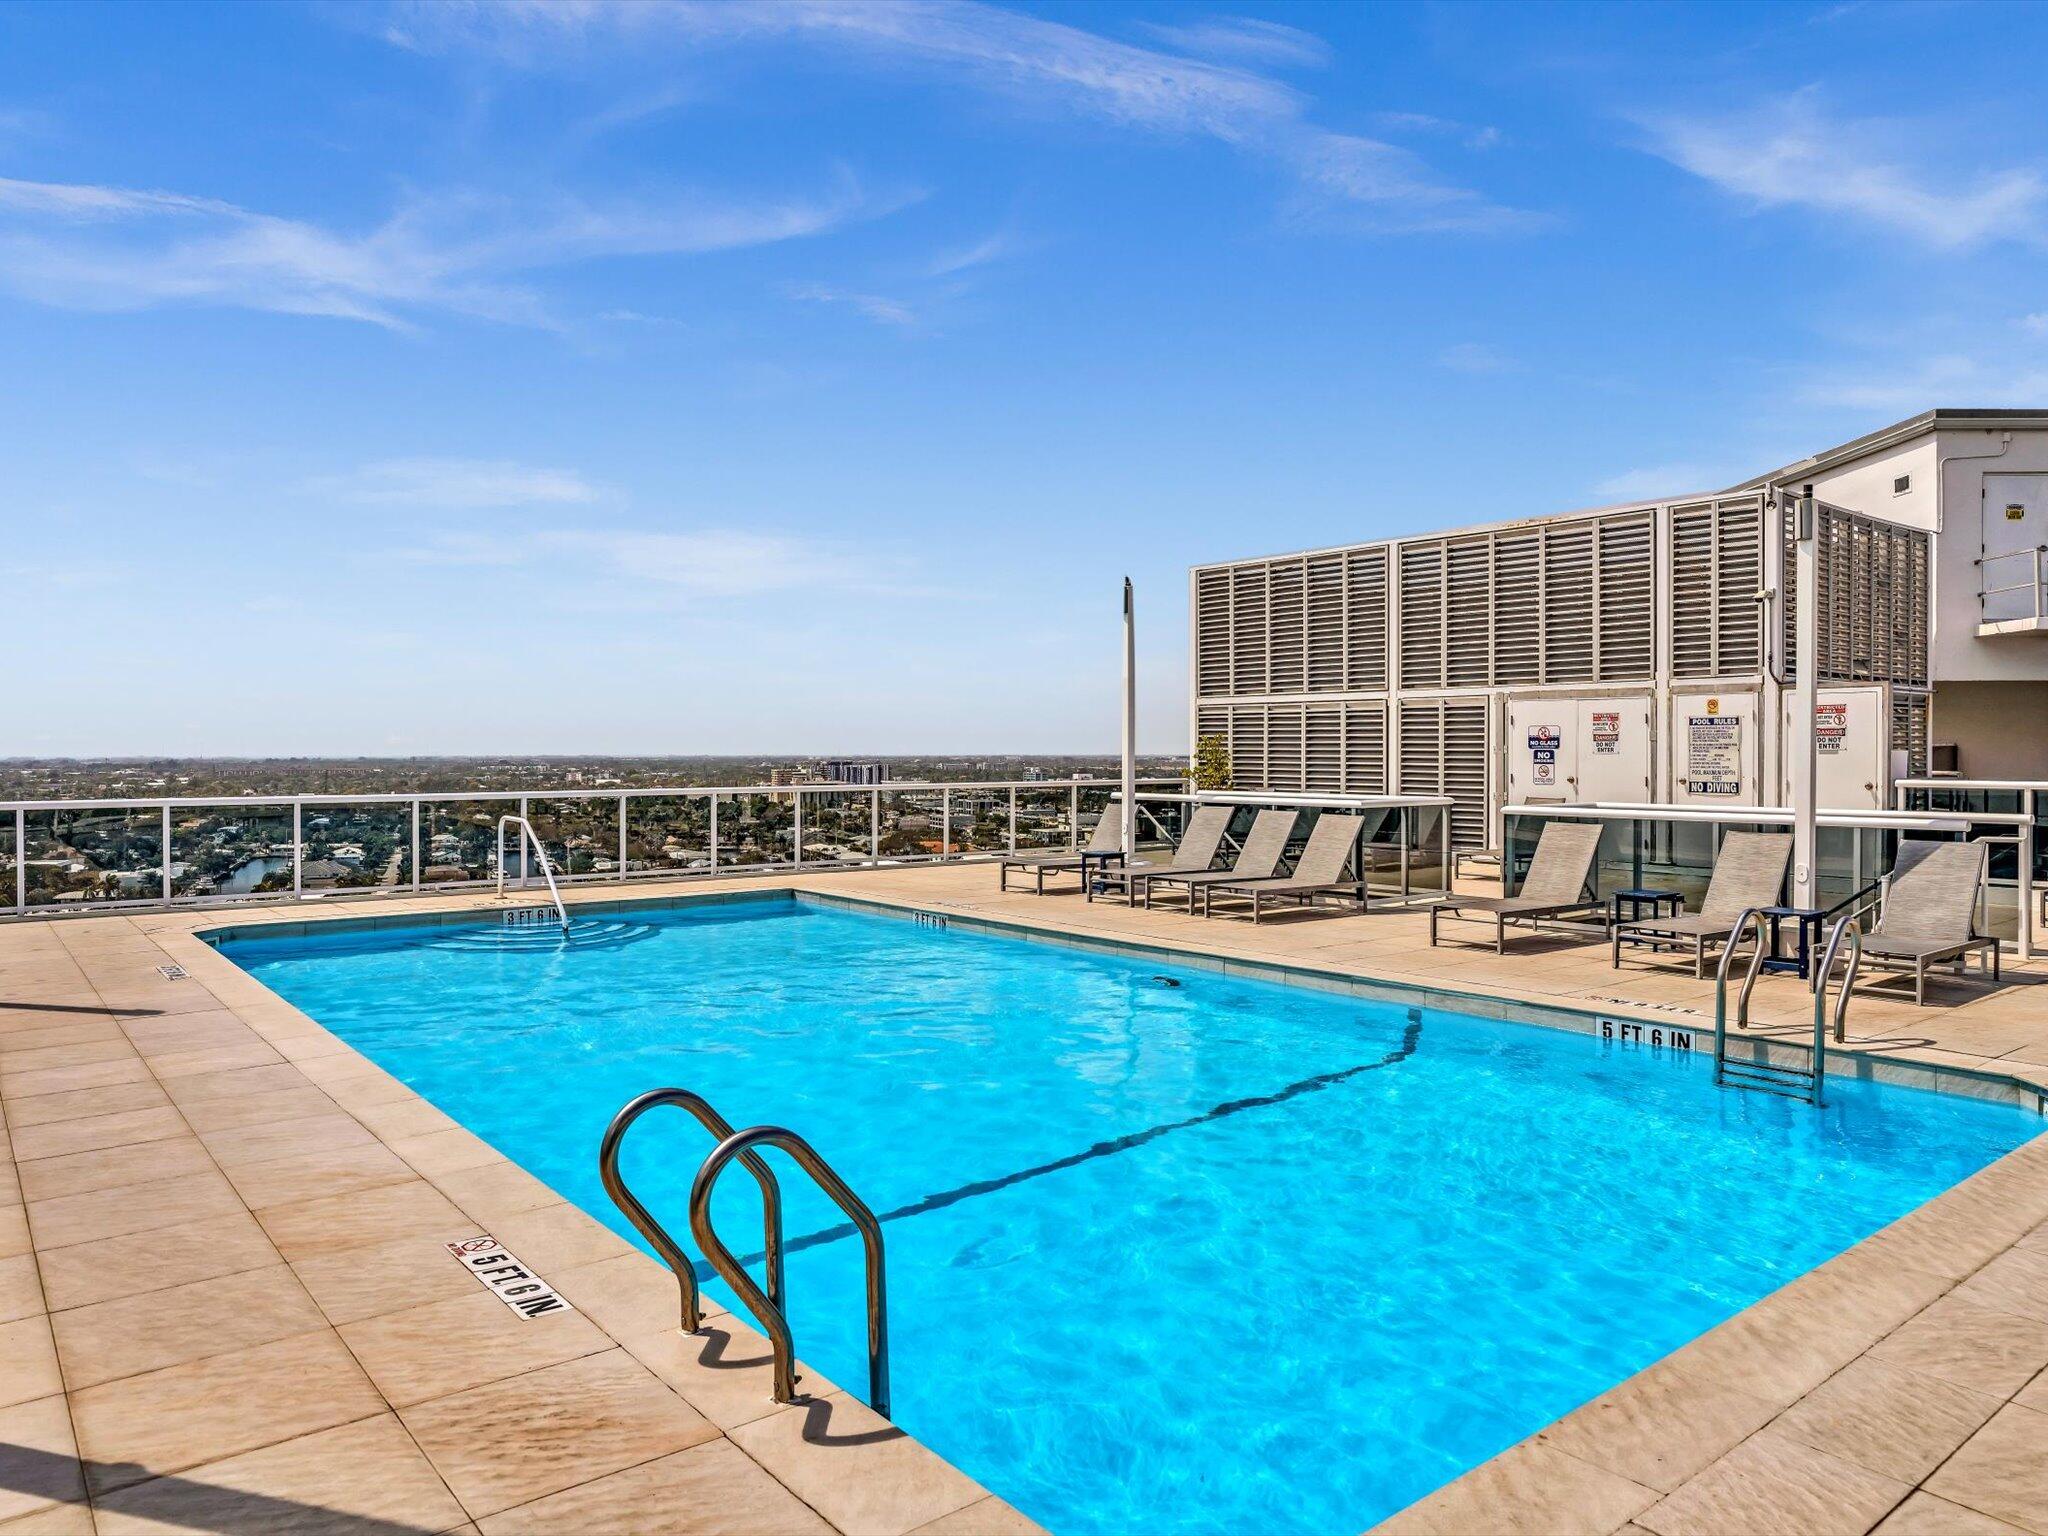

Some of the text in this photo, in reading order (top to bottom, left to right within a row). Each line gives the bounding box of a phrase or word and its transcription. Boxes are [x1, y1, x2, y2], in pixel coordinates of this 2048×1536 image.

[1537, 751, 1551, 759] NO
[1691, 782, 1738, 793] NO DIVING
[507, 911, 515, 923] 3
[519, 909, 532, 923] FT
[537, 909, 544, 922] 6
[1602, 1021, 1691, 1050] 5 FT 6 IN
[472, 1253, 564, 1318] 5 FT. 6 IN.
